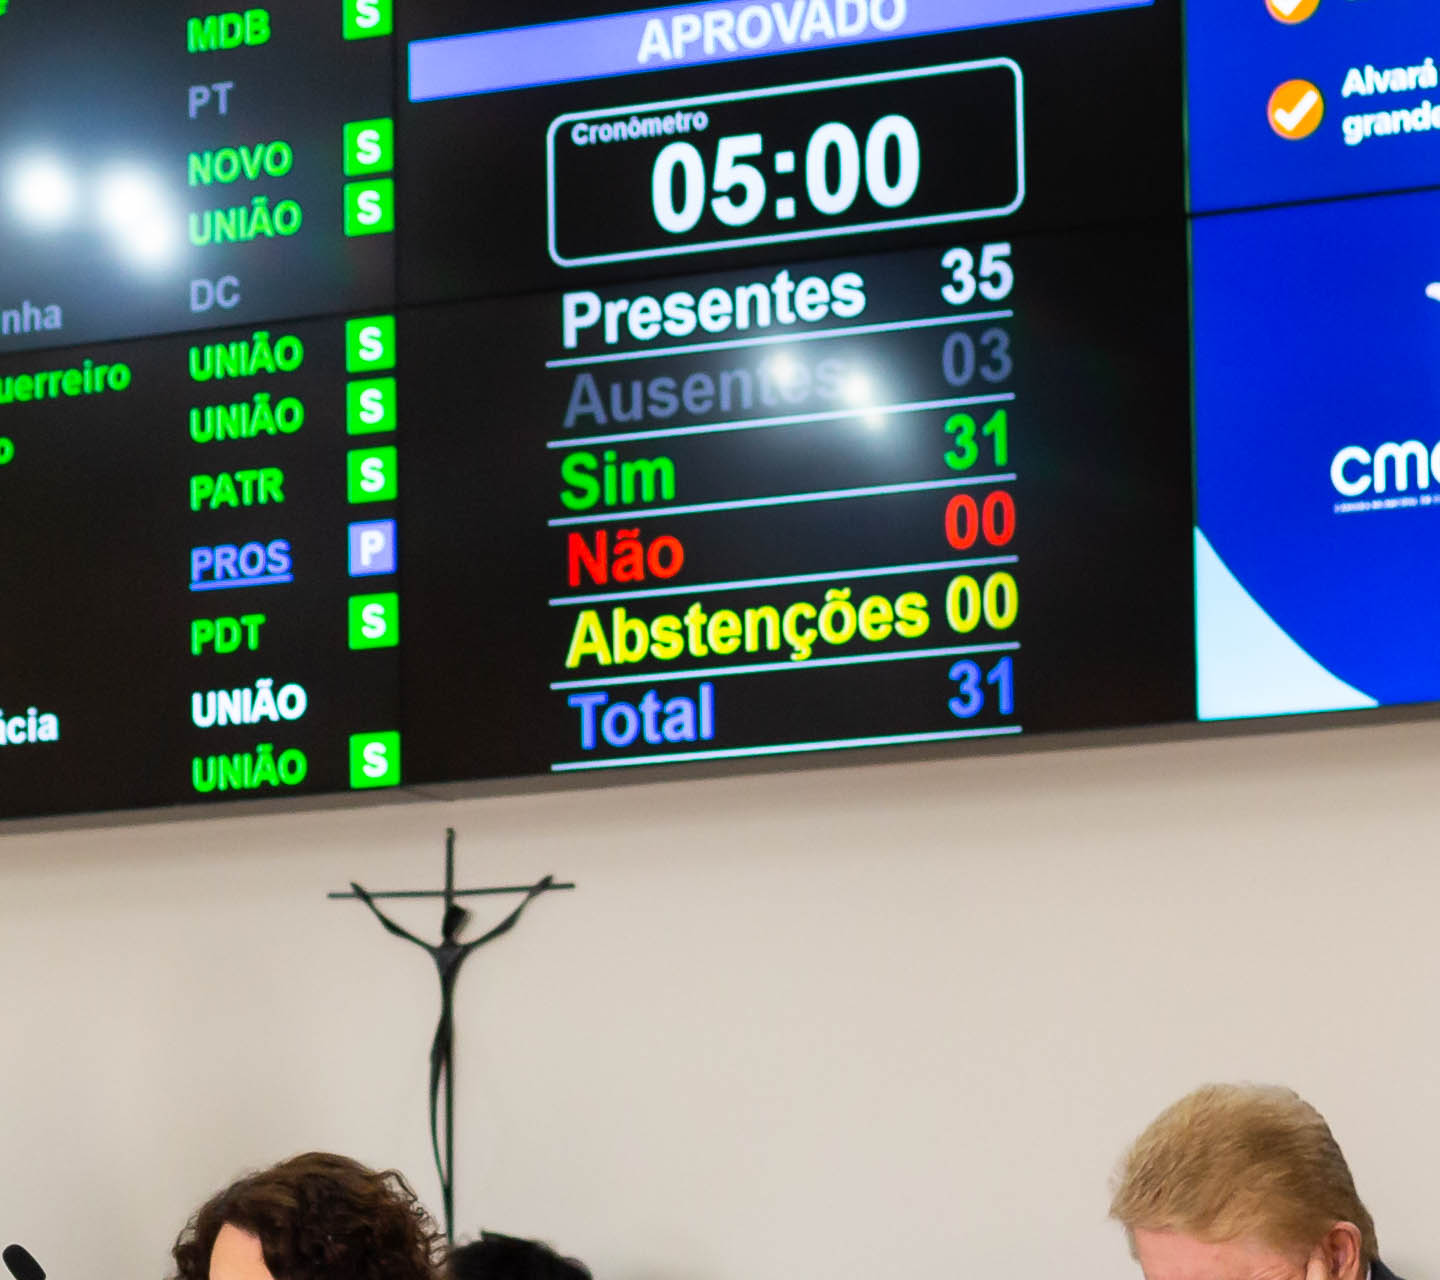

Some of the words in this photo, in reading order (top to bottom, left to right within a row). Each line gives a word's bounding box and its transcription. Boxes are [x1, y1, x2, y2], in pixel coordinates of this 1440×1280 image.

[1343, 57, 1439, 98] Alvará
[571, 109, 709, 146] Cronômetro
[651, 115, 921, 232] 05:00
[562, 269, 866, 349] Presentes
[941, 242, 1014, 306] 35
[941, 328, 1012, 387] 03
[190, 467, 285, 511] PATR
[561, 450, 675, 510] Sim
[943, 410, 1007, 471] 31
[189, 538, 295, 581] PROS
[568, 527, 684, 587] Não
[944, 490, 1016, 550] 00
[565, 589, 930, 668] Abstenções
[945, 571, 1019, 634] 00
[191, 677, 308, 728] UNIÃO
[567, 681, 715, 750] Total
[948, 656, 1014, 719] 31
